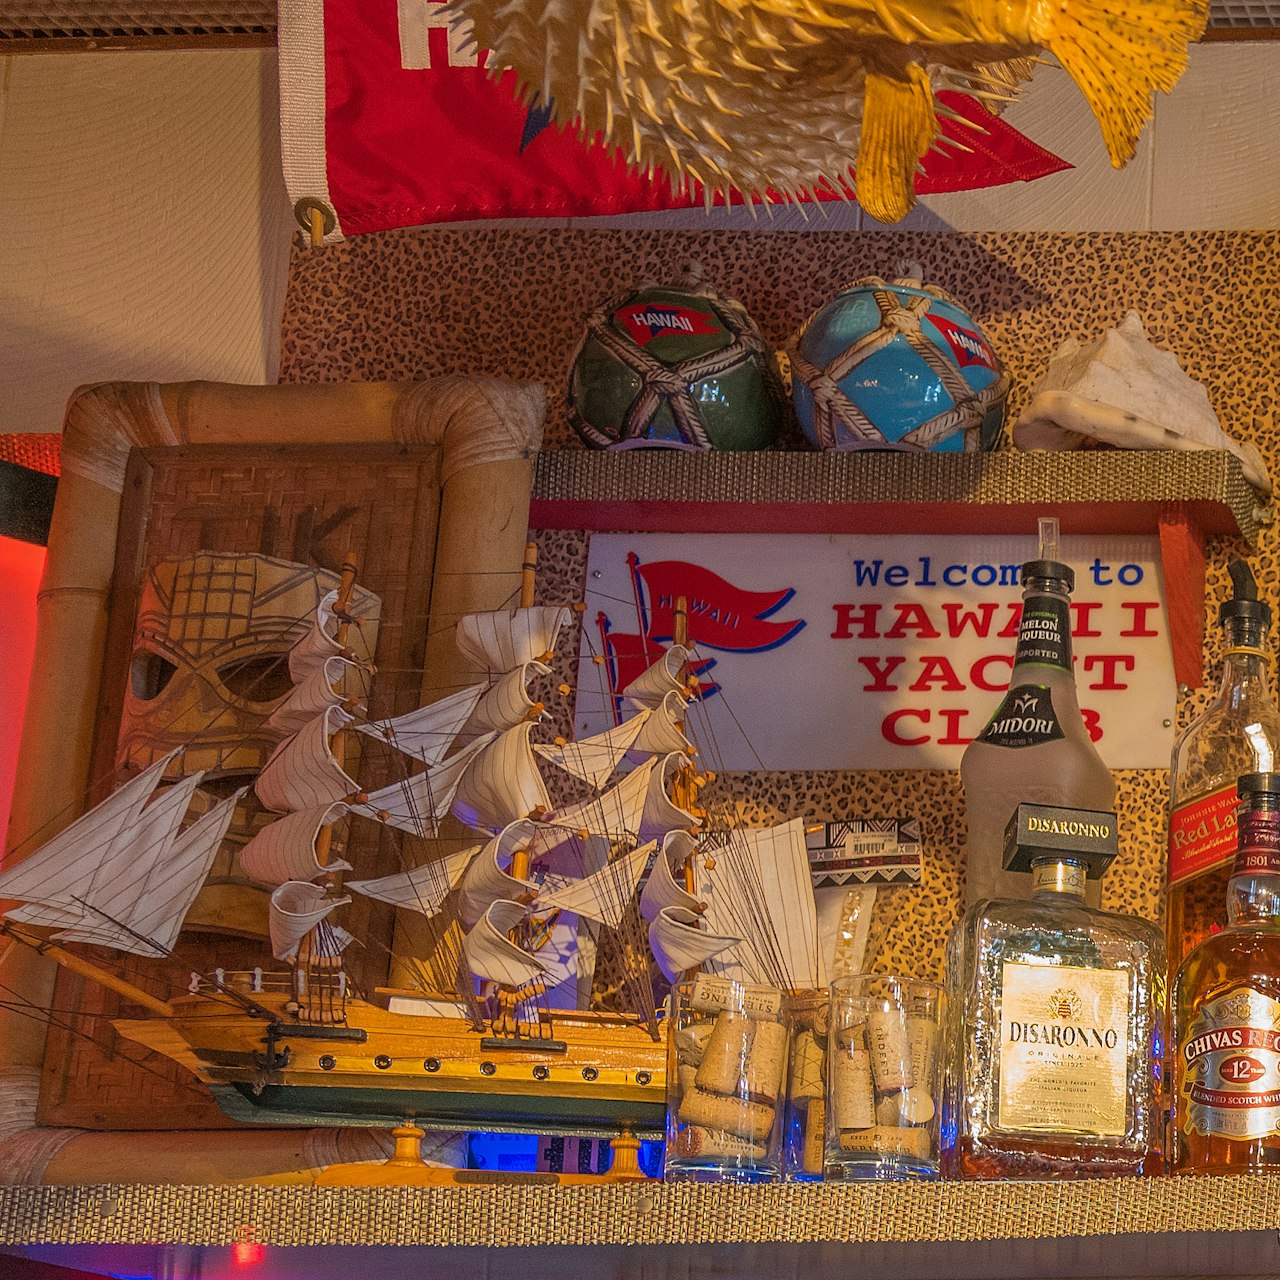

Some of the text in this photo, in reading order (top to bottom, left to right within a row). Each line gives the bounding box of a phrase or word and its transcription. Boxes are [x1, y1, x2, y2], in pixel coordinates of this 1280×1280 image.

[633, 311, 694, 332] HAWAII
[854, 557, 1144, 587] Welcom to
[831, 602, 1160, 639] HAWII
[858, 655, 1135, 692] YACT
[988, 717, 1055, 735] MIDORI
[1028, 816, 1109, 840] DISARONNO
[1173, 820, 1210, 850] Red
[1010, 1022, 1117, 1049] DISARONNO
[1185, 1030, 1242, 1060] CHIVAS
[1232, 1060, 1250, 1078] 12
[1193, 1090, 1225, 1104] BLENDED
[1228, 1096, 1262, 1104] SCOTCH
